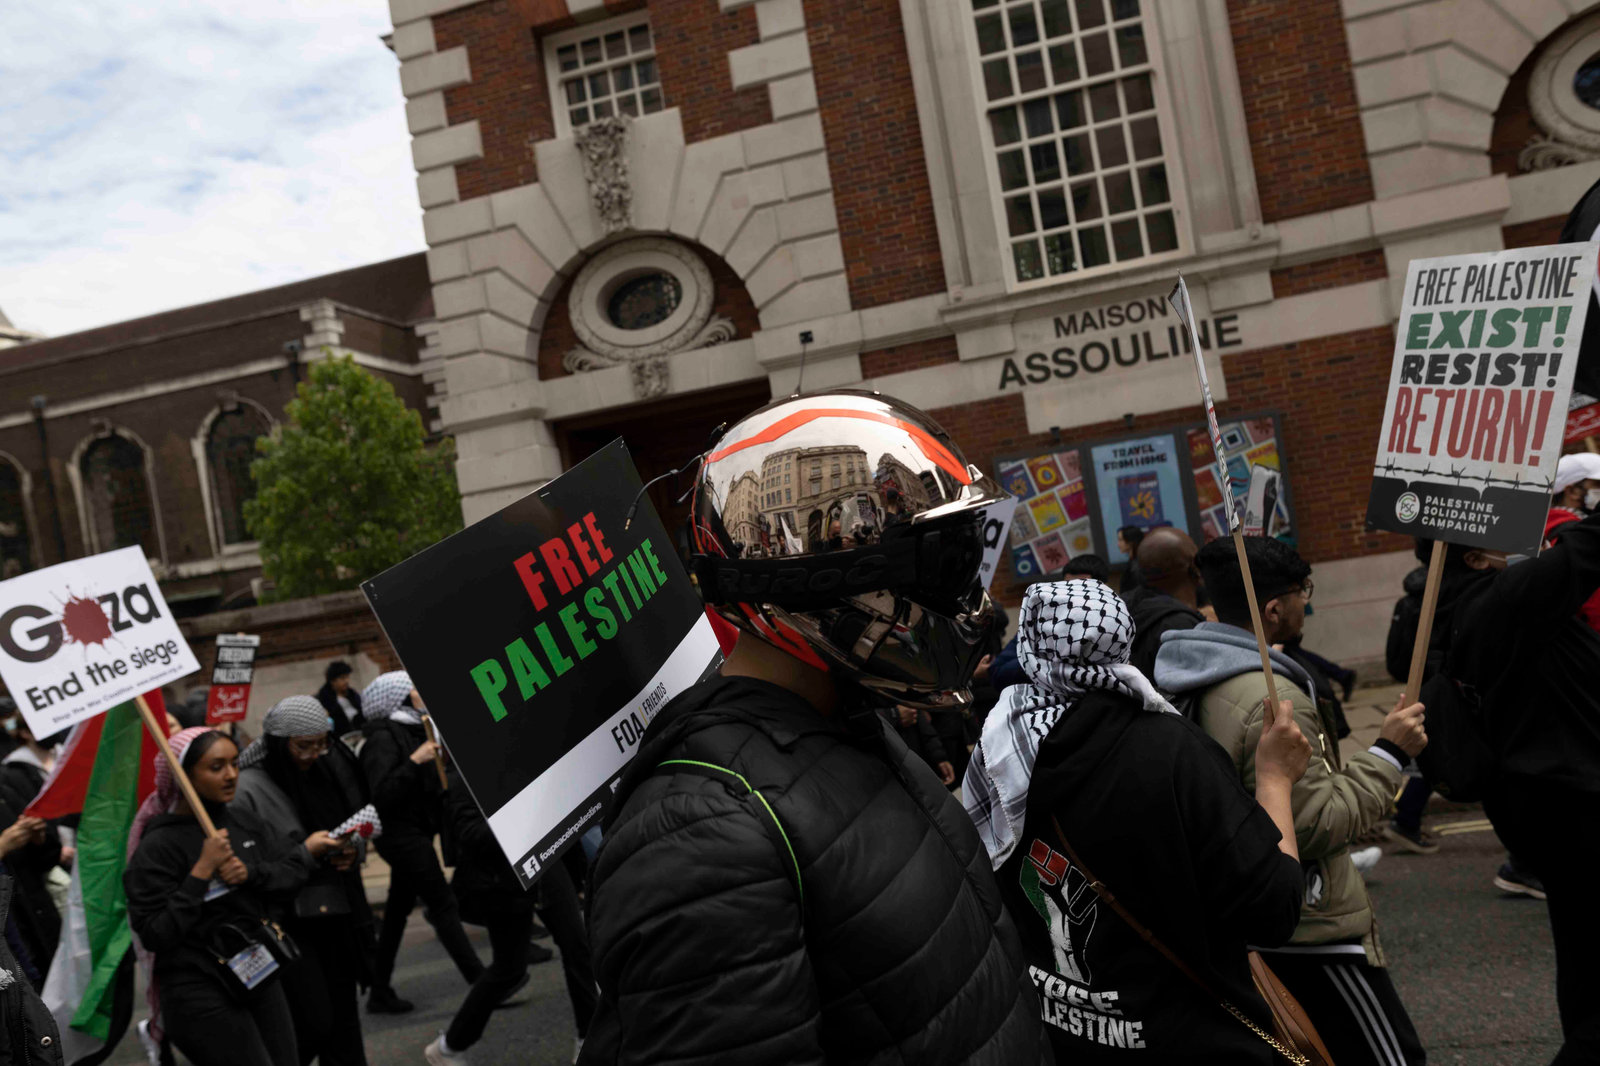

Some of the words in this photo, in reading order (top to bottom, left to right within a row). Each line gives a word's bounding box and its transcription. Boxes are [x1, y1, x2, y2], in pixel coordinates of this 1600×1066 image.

[1413, 267, 1461, 307] FREE
[1461, 256, 1582, 304] PALESTINE
[1053, 296, 1168, 339] MAISON
[1405, 306, 1573, 350] EXIST!
[998, 314, 1243, 390] ASSOULINE
[1400, 352, 1563, 388] RESIST!
[1387, 386, 1555, 467] RETURN!
[1112, 443, 1155, 458] TRAVEL
[1400, 502, 1415, 513] PSC
[1421, 516, 1488, 535] CAMPAIGN
[1423, 506, 1500, 525] SOLIDARITY
[1425, 495, 1494, 513] PALESTINE
[513, 511, 614, 612] FREE
[469, 537, 669, 723] PALESTINE
[25, 672, 84, 712] End
[86, 658, 128, 687] the
[130, 639, 179, 669] siege
[642, 681, 667, 716] FRIENDS
[611, 711, 645, 754] FOA
[539, 801, 602, 862] foapeaceinpalestine
[1038, 996, 1147, 1049] LESTINE
